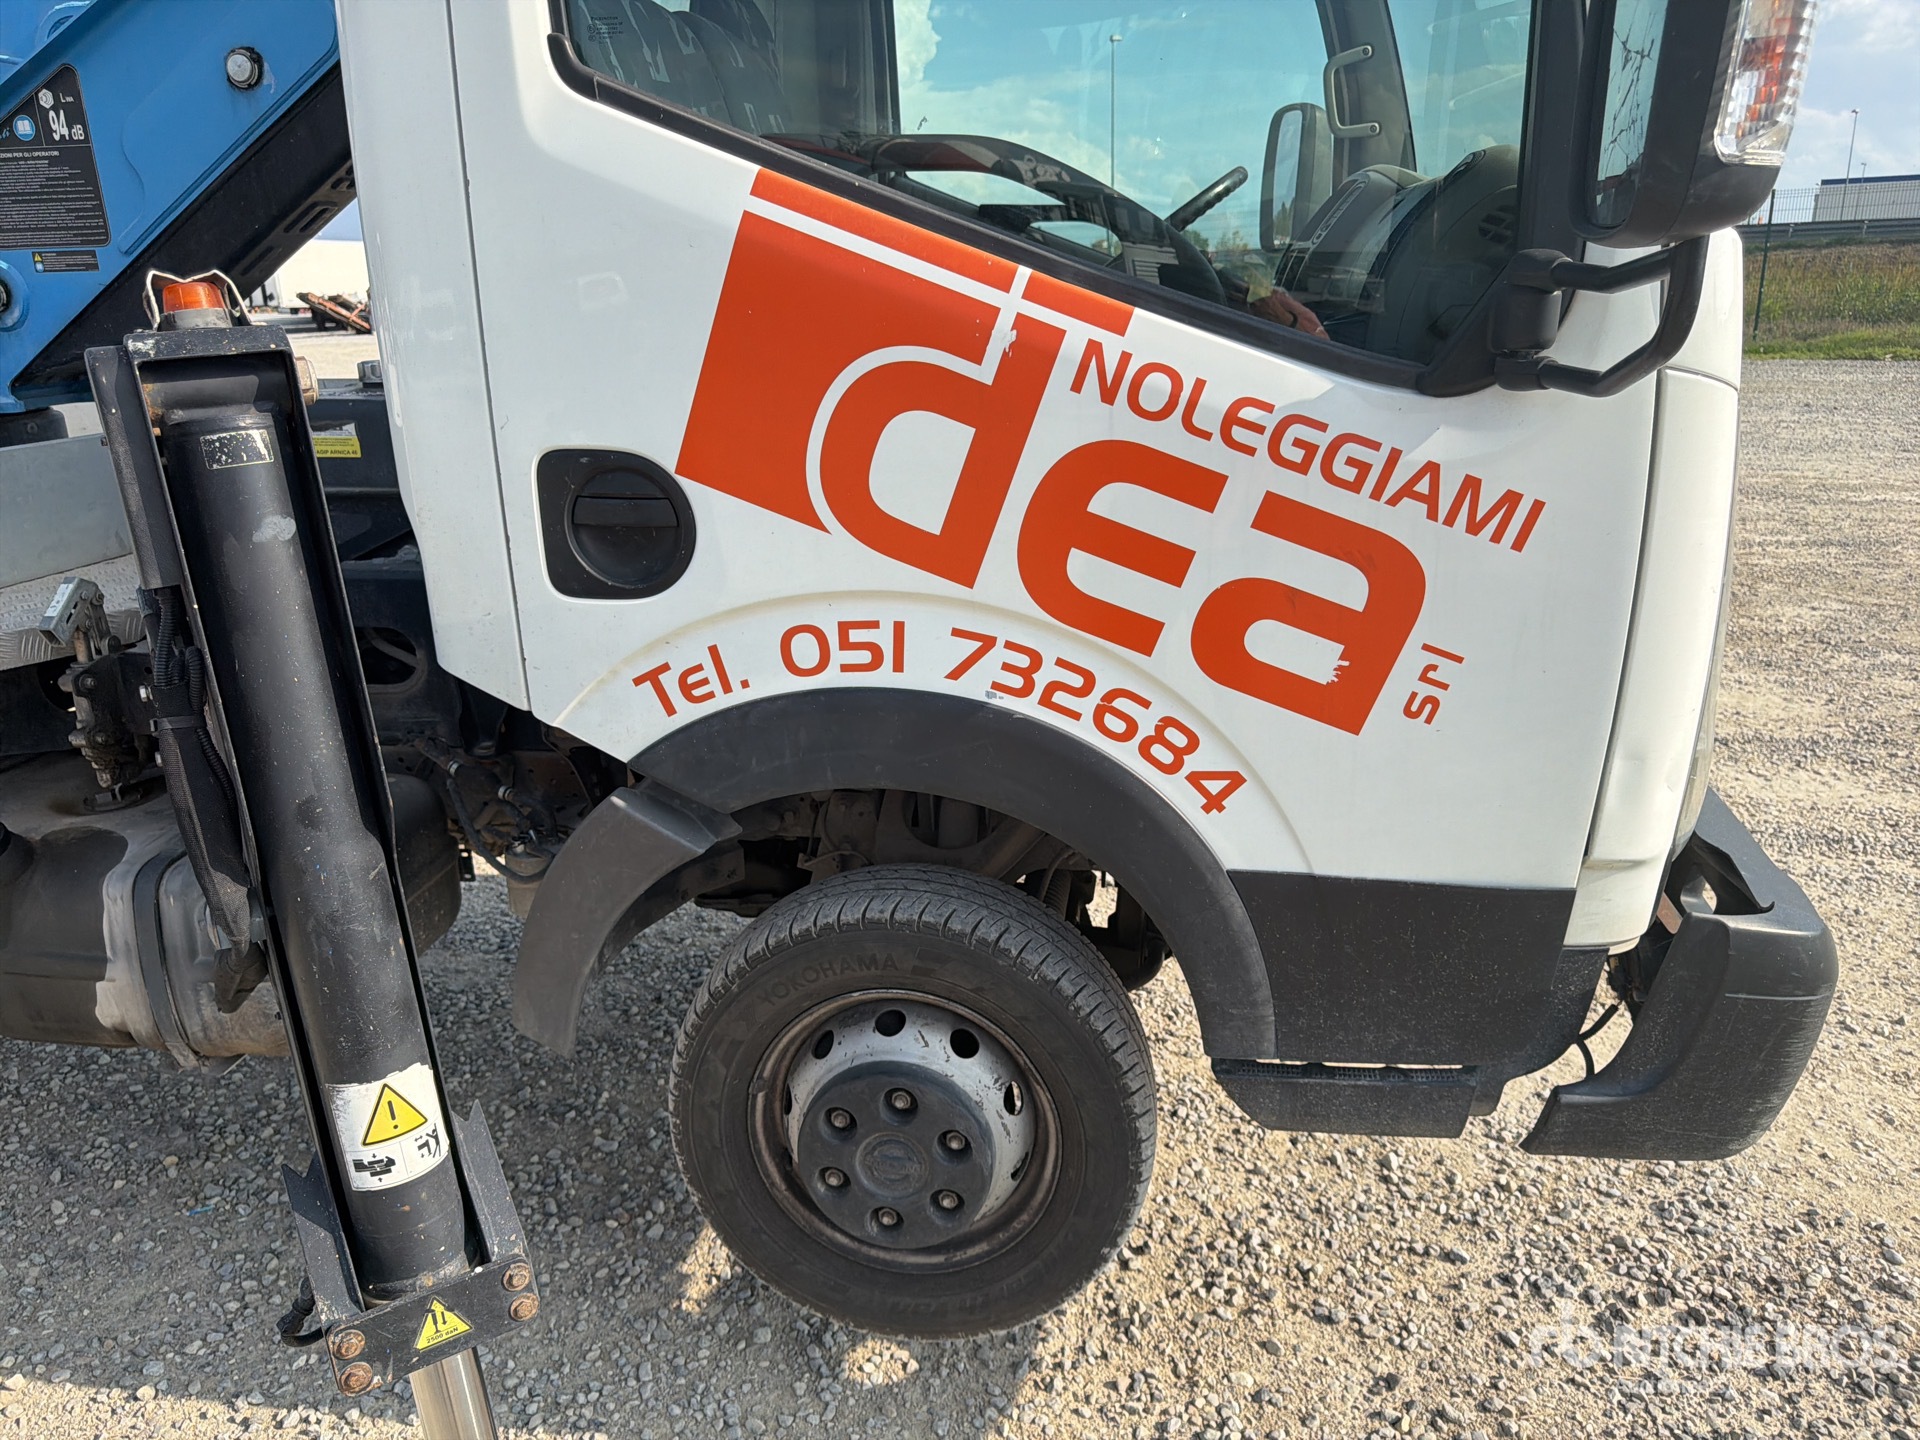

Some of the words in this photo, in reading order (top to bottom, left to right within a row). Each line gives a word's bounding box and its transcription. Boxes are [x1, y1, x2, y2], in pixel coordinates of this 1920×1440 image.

[48, 109, 70, 142] 94
[71, 124, 85, 141] dB
[1072, 338, 1546, 552] NOLEGGIAMI
[632, 645, 749, 717] Tel.
[780, 620, 905, 677] 051
[945, 627, 1247, 814] 732684
[1402, 642, 1465, 725] srl
[756, 952, 900, 1007] YOKOHAMA
[426, 1333, 444, 1344] 2500
[445, 1326, 459, 1336] daN
